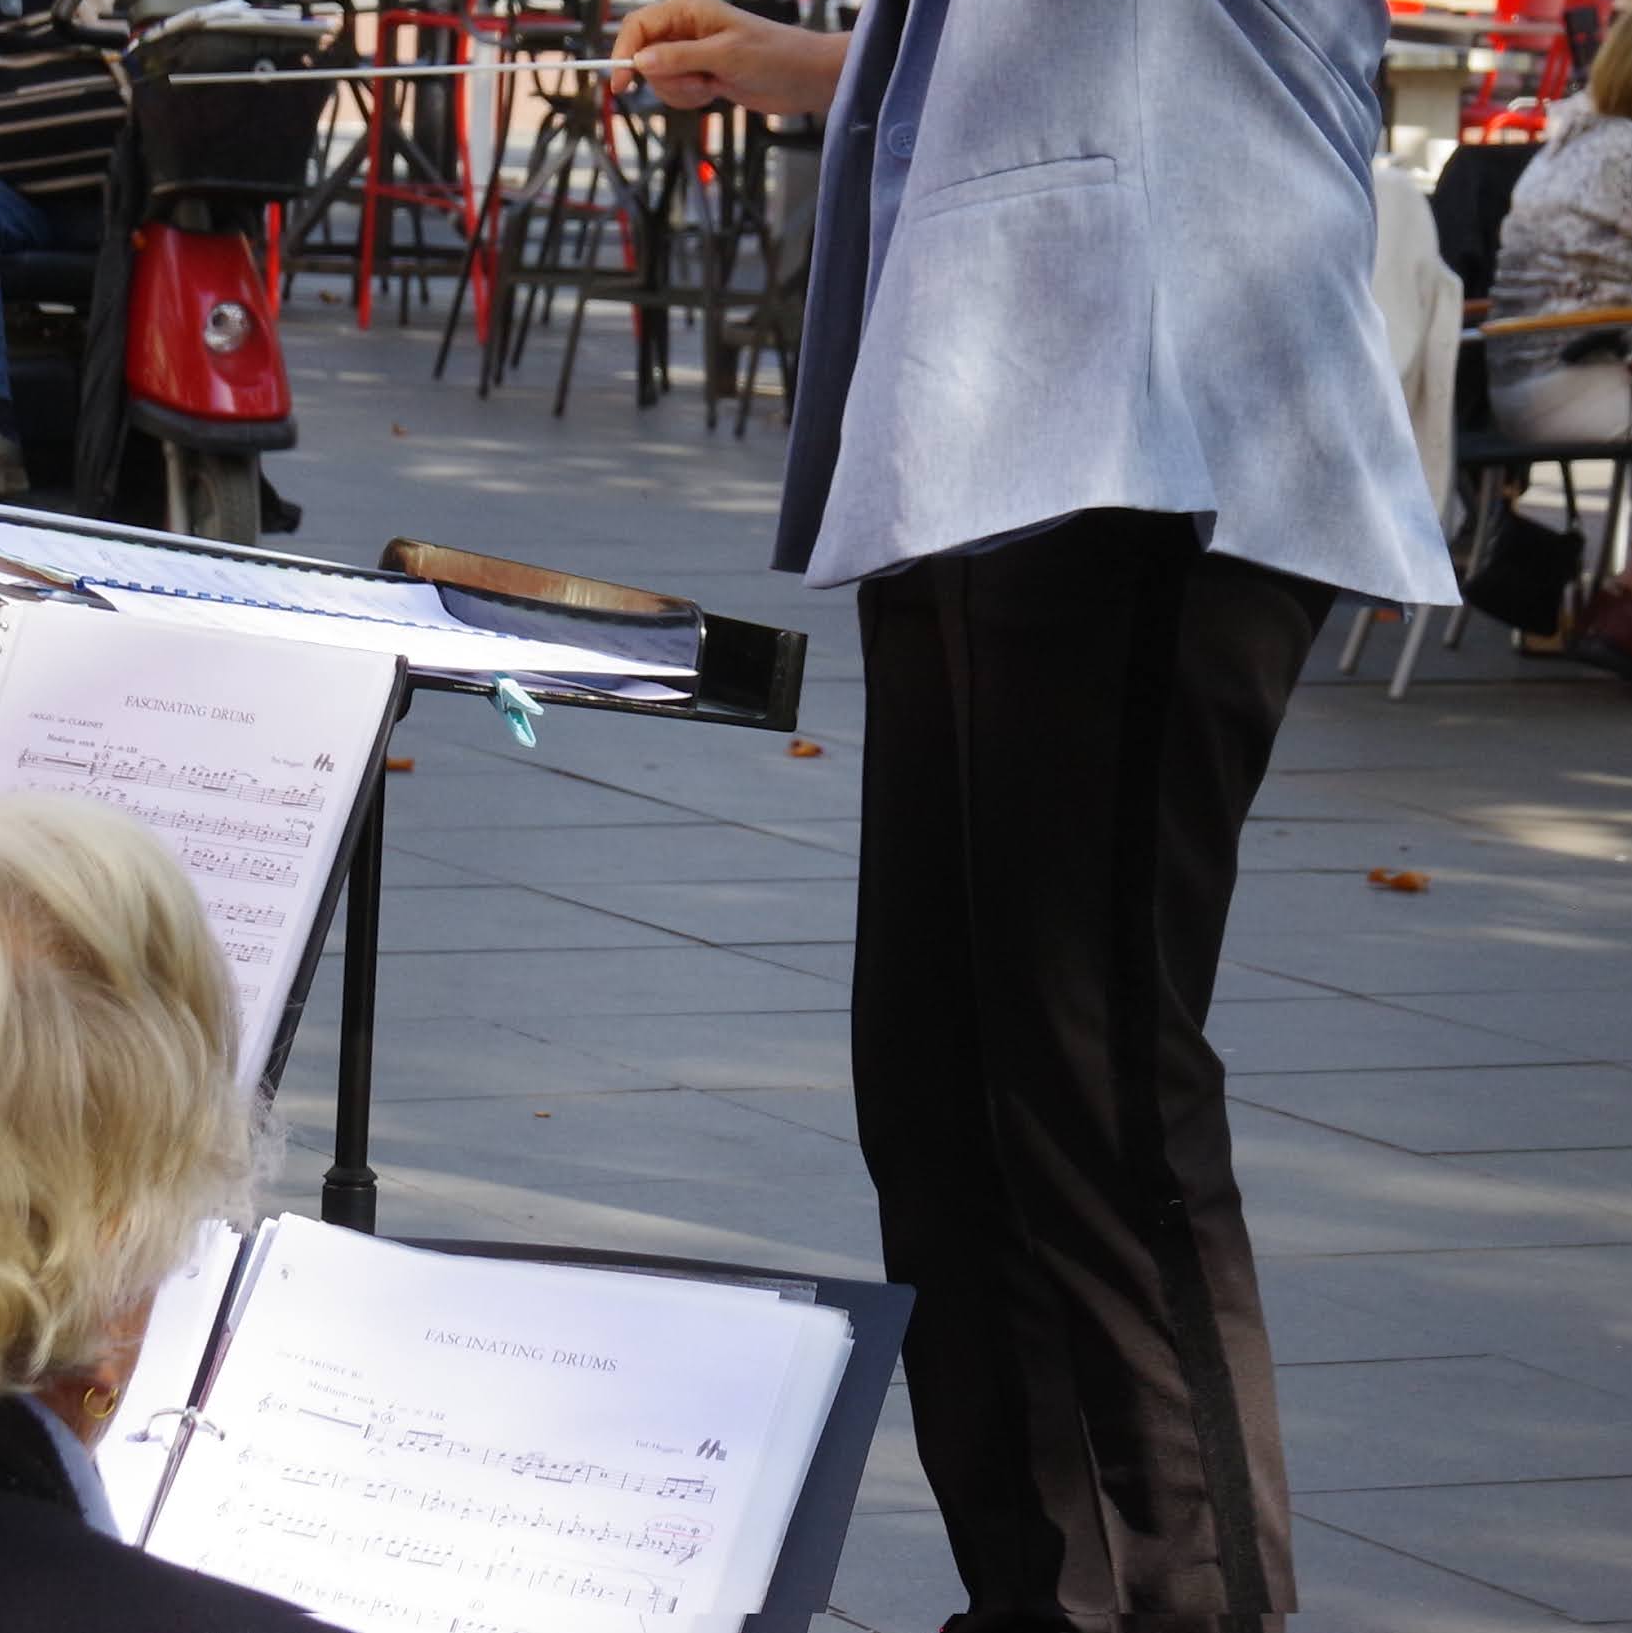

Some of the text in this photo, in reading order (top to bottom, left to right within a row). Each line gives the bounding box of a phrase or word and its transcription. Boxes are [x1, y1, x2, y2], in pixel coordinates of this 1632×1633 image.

[124, 694, 257, 725] FASCINATING DRUMS
[424, 1327, 619, 1373] FASCINATING DRUMS
